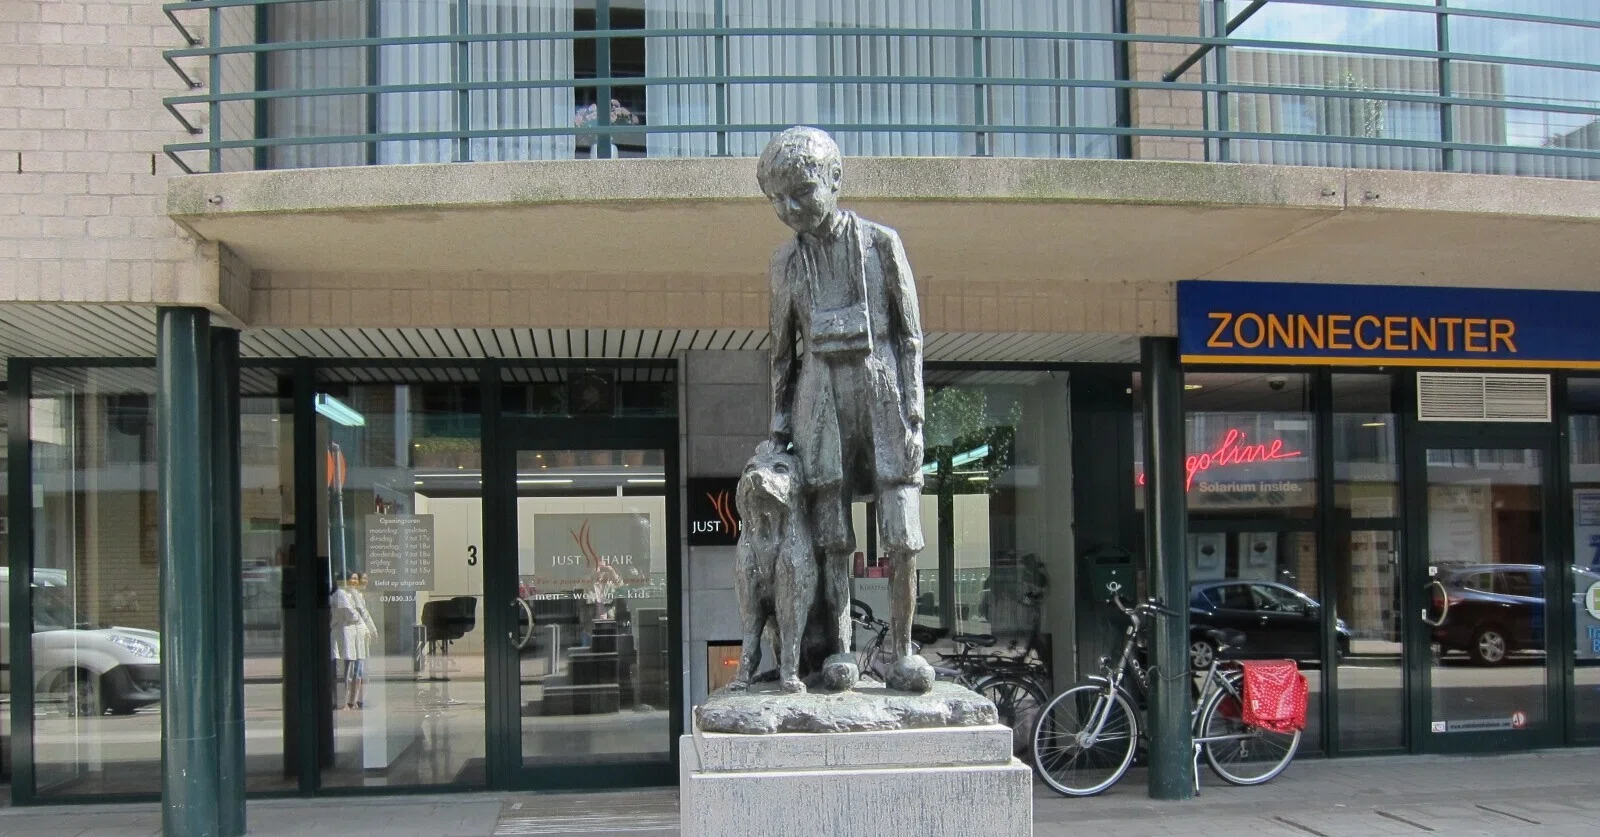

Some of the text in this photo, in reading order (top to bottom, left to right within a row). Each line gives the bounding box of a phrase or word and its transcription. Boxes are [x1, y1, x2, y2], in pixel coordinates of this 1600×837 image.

[1206, 312, 1517, 353] ZONNECENTER
[1138, 429, 1301, 492] goline
[1199, 481, 1303, 492] Solarium inside.
[692, 520, 722, 534] JUST
[467, 544, 478, 566] 3
[551, 554, 634, 567] JUST HAIR
[535, 593, 562, 601] men
[573, 591, 614, 600] woen
[627, 589, 650, 599] kids
